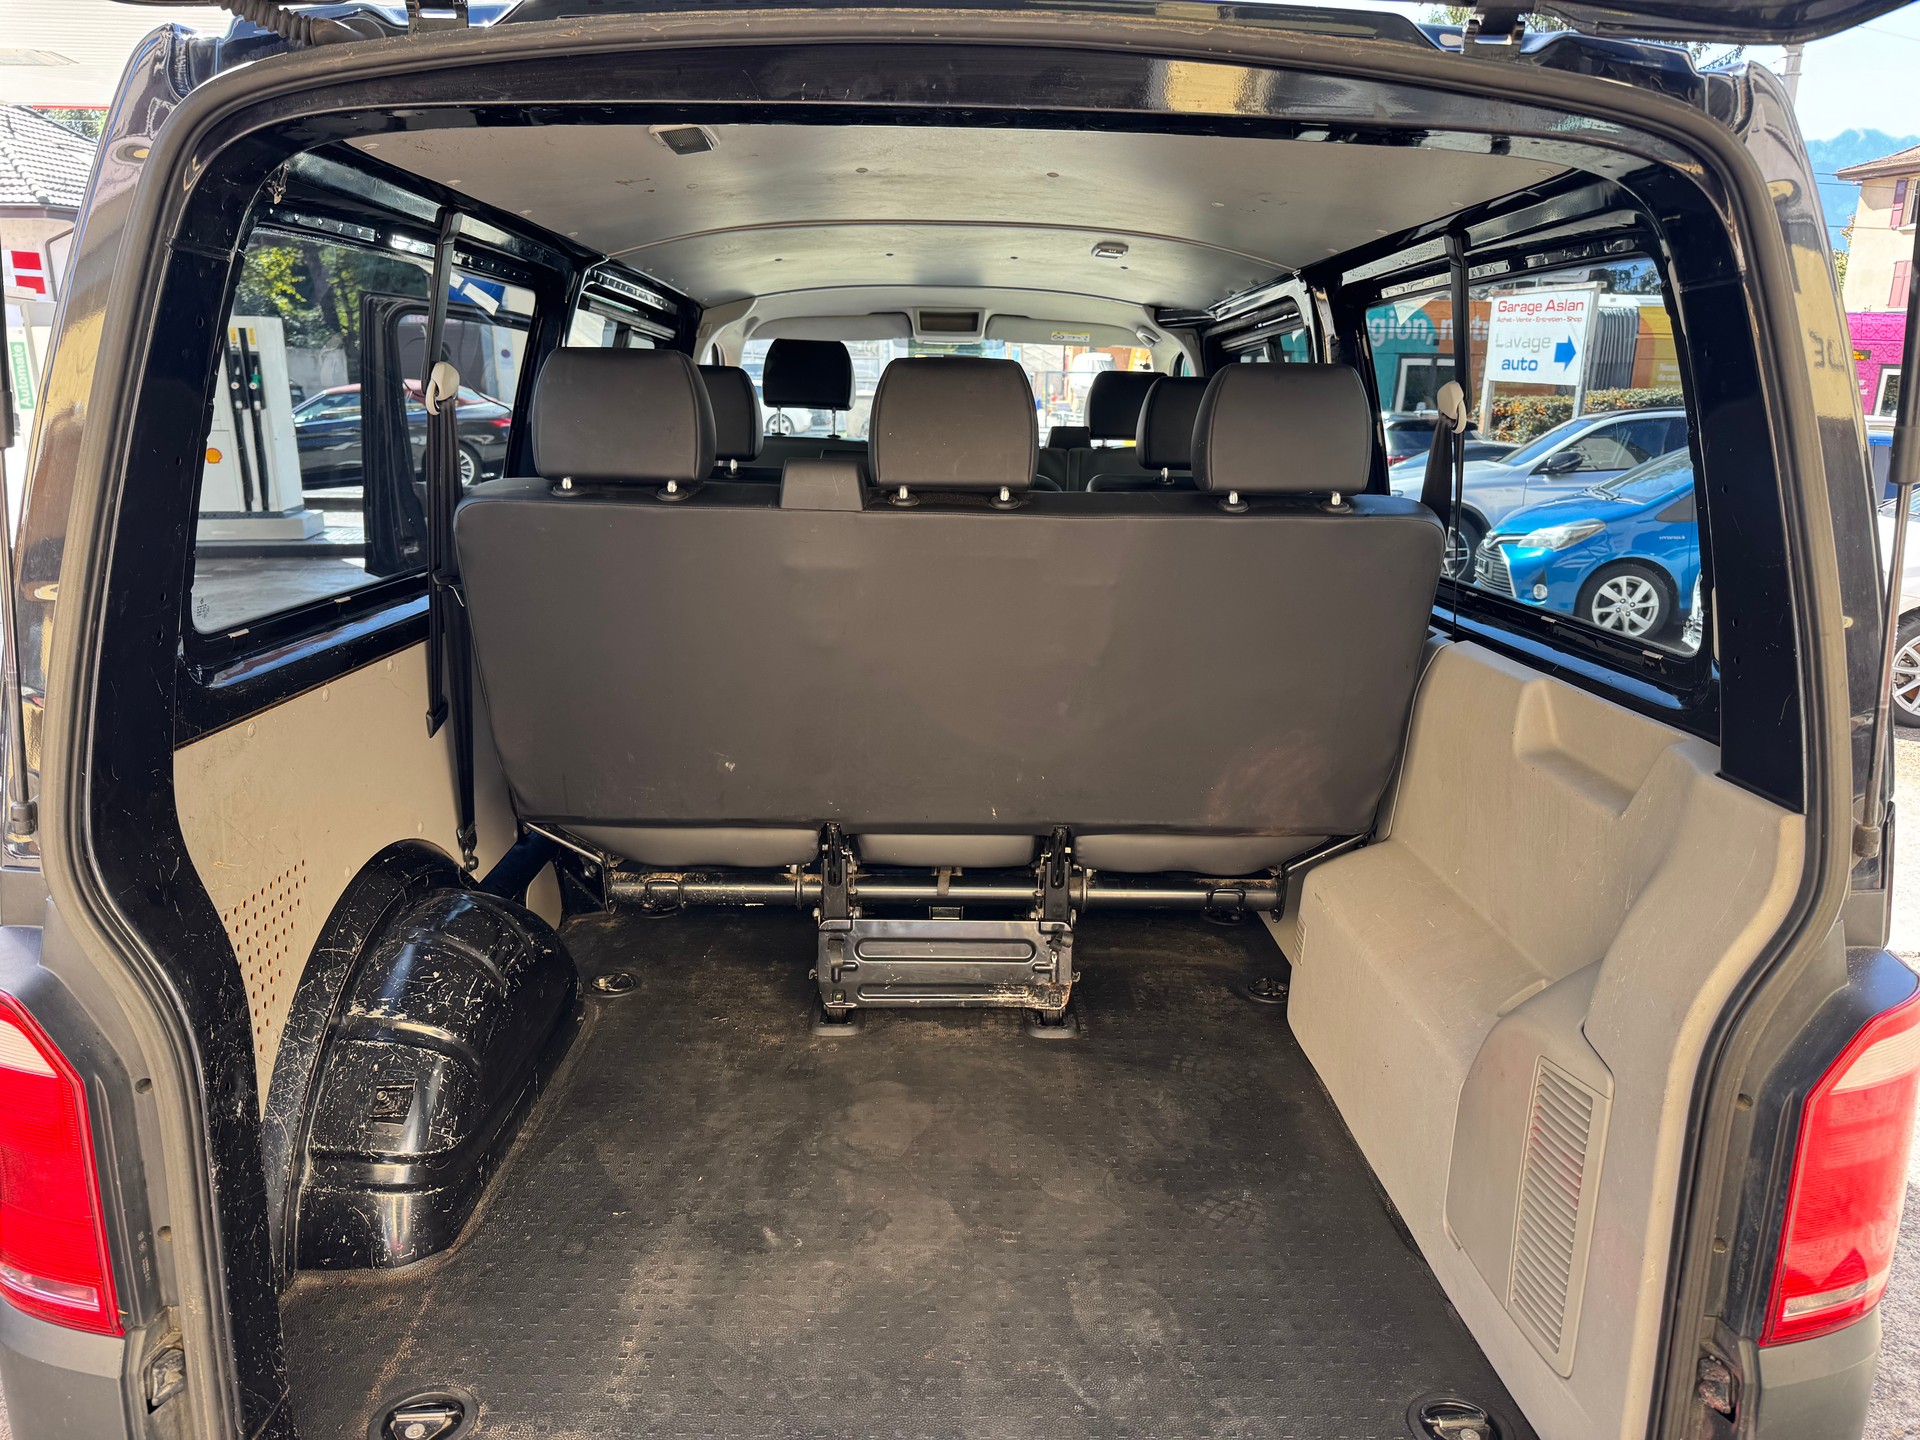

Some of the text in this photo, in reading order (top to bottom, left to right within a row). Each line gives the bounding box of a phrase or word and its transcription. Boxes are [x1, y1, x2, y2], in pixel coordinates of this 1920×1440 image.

[1498, 298, 1584, 315] Garage Aslan
[1366, 310, 1434, 347] gion,
[1495, 333, 1551, 353] Lavage
[1501, 357, 1539, 371] auto
[13, 344, 32, 407] Automate
